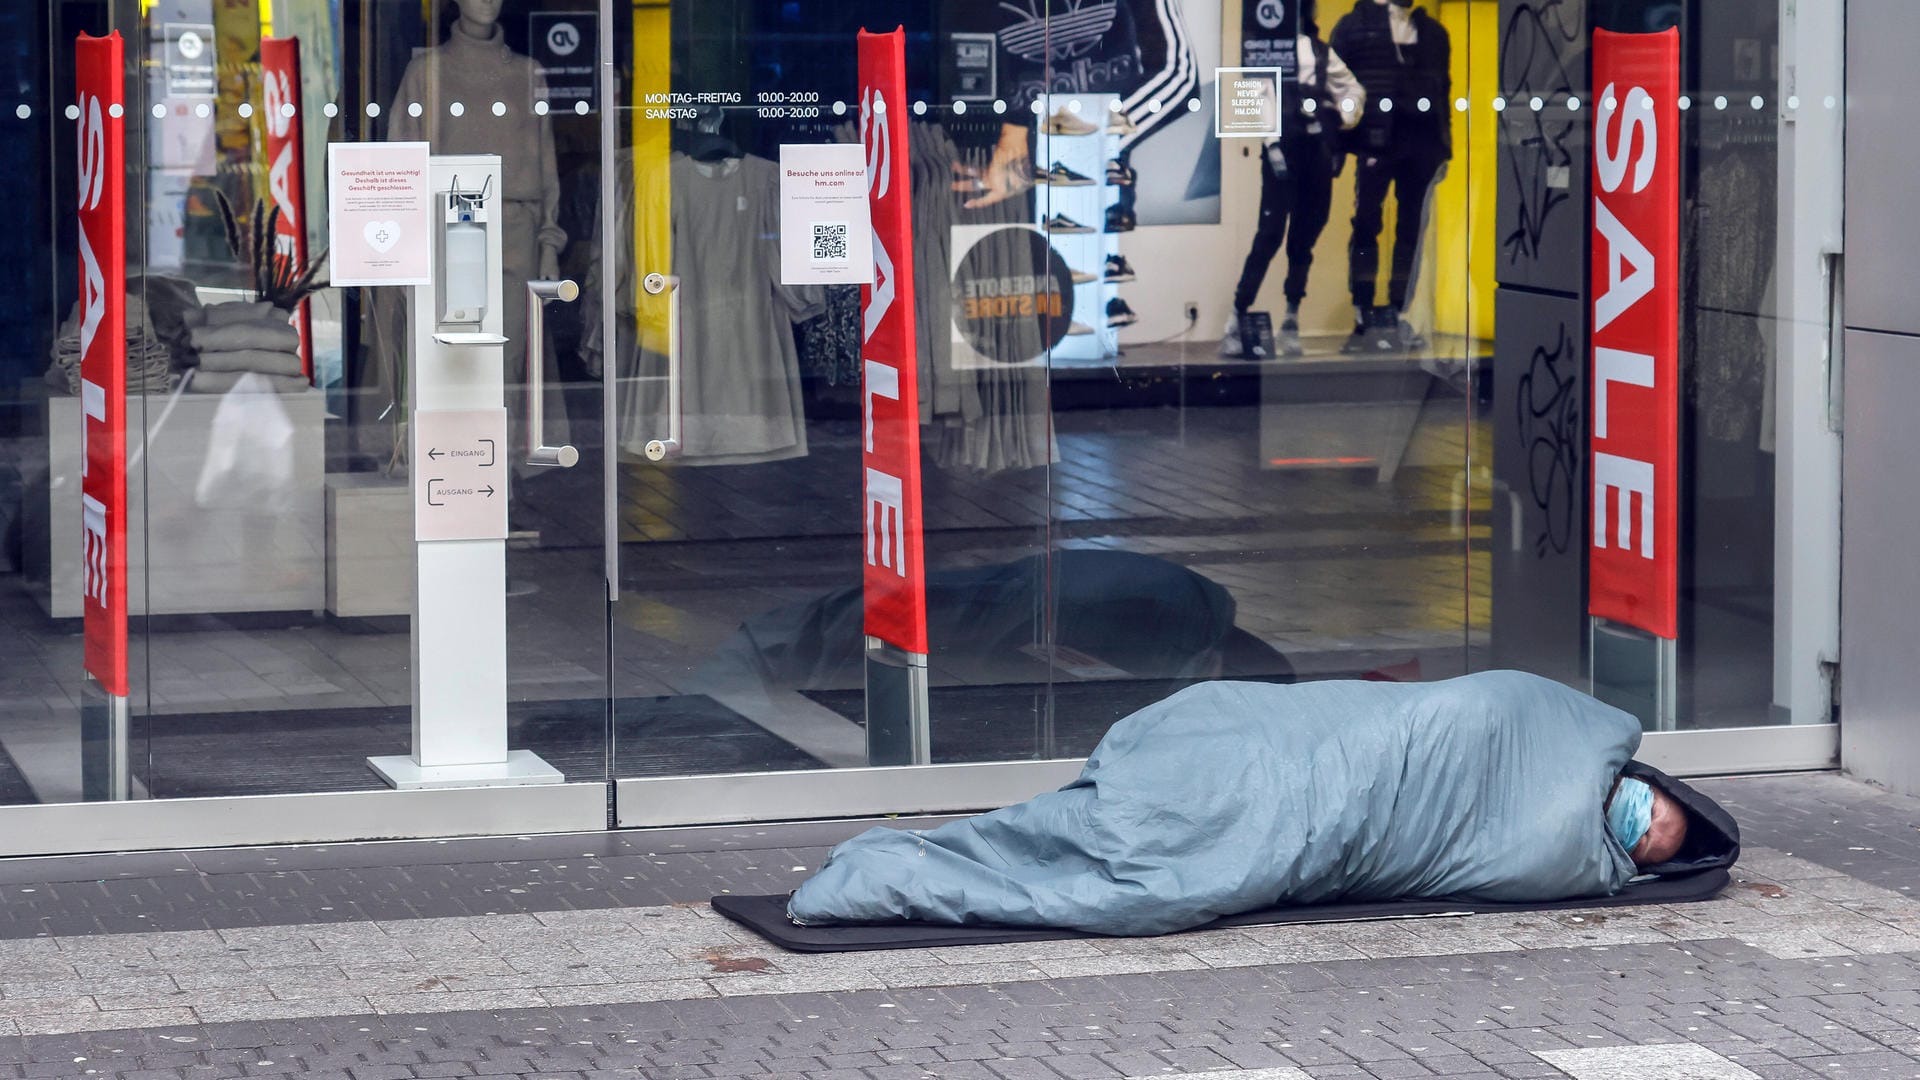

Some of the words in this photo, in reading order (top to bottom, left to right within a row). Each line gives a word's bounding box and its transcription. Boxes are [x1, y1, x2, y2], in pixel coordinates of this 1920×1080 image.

[1233, 80, 1262, 88] FASHION
[645, 92, 742, 104] MONTAG-FREITAG
[757, 92, 819, 103] 10.00-20.00
[645, 108, 698, 119] SAMSTAG
[757, 107, 819, 118] 10.00-20.00
[396, 170, 421, 178] wichtig!
[787, 169, 819, 177] Besuche
[834, 169, 855, 177] online
[855, 169, 865, 177] auf
[814, 179, 845, 187] hm.com
[1594, 82, 1657, 560] SALE
[860, 85, 905, 577] SALE
[78, 90, 107, 608] SALE
